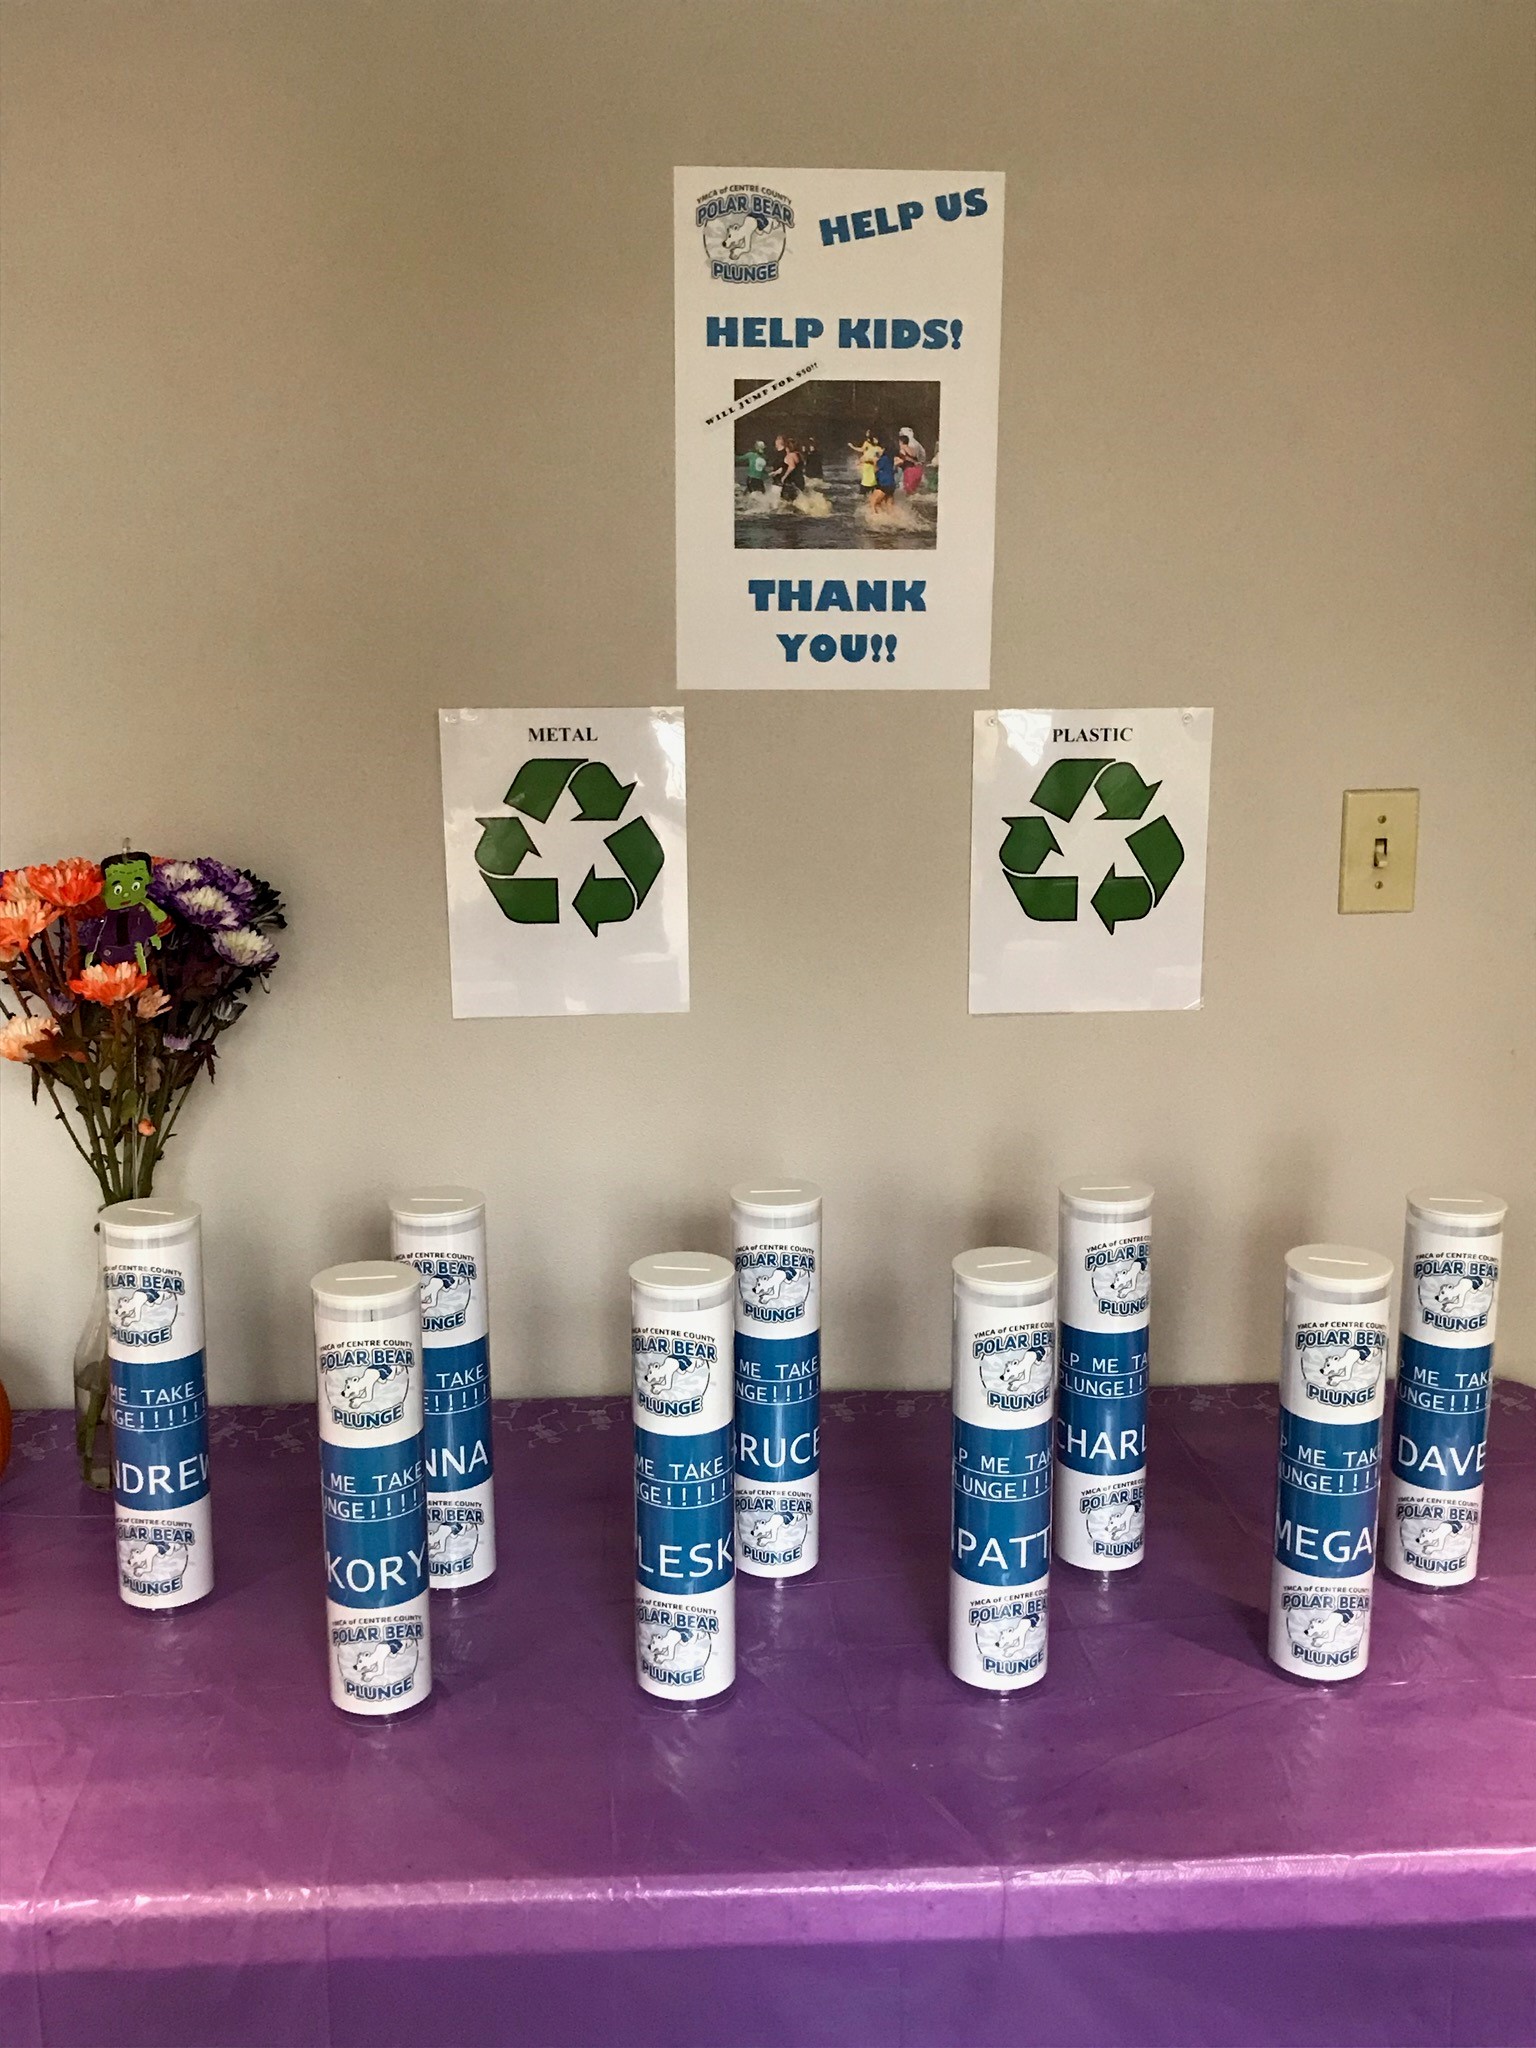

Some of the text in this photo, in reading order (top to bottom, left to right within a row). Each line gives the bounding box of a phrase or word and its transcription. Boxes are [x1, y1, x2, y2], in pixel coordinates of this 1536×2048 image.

[697, 184, 792, 205] YMCA of CENTRE COUNTY
[697, 195, 793, 227] POLAR BEAR
[819, 187, 988, 246] HELP US
[712, 261, 778, 282] PLUNGE
[706, 316, 963, 350] HELP KIDS!
[705, 407, 735, 425] WILL
[739, 389, 768, 409] JUMP
[772, 376, 794, 390] FOR
[748, 579, 927, 612] THANK
[776, 634, 898, 663] YOU!!
[528, 727, 598, 742] METAL
[1052, 727, 1134, 743] PLASTIC
[447, 1253, 475, 1261] COUNTY
[790, 1246, 814, 1254] COUNTY
[1086, 1245, 1135, 1270] POLAR
[1087, 1243, 1107, 1253] YMCA
[151, 1267, 182, 1277] COUNTY
[439, 1261, 476, 1278] BEAR
[736, 1253, 815, 1272] POLAR BEAR
[1415, 1261, 1463, 1278] POLAR
[142, 1276, 183, 1293] BEAR
[422, 1312, 465, 1330] UNGE
[744, 1303, 804, 1322] PLUNGE
[1424, 1310, 1487, 1331] PLUNGE
[650, 1328, 681, 1336] CENTRE
[684, 1331, 715, 1343] COUNTY
[974, 1329, 996, 1339] YMCA
[1009, 1323, 1039, 1332] CENTRE
[1296, 1331, 1350, 1348] POLAR
[347, 1340, 380, 1348] CENTRE
[383, 1340, 412, 1348] COUNTY
[634, 1336, 716, 1361] OLAR BEAR
[974, 1333, 1029, 1358] POLAR
[320, 1349, 414, 1372] POLAR BEAR
[740, 1355, 818, 1379] ME TAKE
[1092, 1358, 1119, 1373] ME
[436, 1363, 484, 1388] TAKE
[1414, 1366, 1440, 1387] ME
[140, 1381, 195, 1405] TAKE
[988, 1386, 1050, 1410] PLUNGE
[1308, 1384, 1376, 1405] PLUNGE
[638, 1393, 701, 1416] PLUNGE
[333, 1404, 403, 1428] PLUNGE
[981, 1456, 1010, 1474] ME
[1298, 1445, 1326, 1466] ME
[1399, 1434, 1487, 1476] DAVE
[330, 1460, 422, 1493] ME TAKE
[668, 1456, 723, 1480] TAKE
[1081, 1487, 1101, 1496] YMCA
[1081, 1491, 1128, 1512] POLAR
[446, 1509, 484, 1524] BEAR
[736, 1498, 813, 1514] POLAR BEAR
[1396, 1505, 1443, 1519] POLAR
[152, 1527, 194, 1544] BEAR
[638, 1531, 733, 1578] LESK
[743, 1545, 801, 1564] PLUNGE
[1405, 1551, 1466, 1572] PLUNGE
[326, 1541, 426, 1593] KORY
[430, 1556, 473, 1575] UNGE
[653, 1601, 683, 1610] CENTRE
[685, 1605, 717, 1615] COUNTY
[970, 1598, 991, 1607] YMCA
[1283, 1595, 1334, 1609] POLAR
[639, 1607, 718, 1632] OLAR BEAR
[970, 1603, 1023, 1624] POLAR
[332, 1624, 424, 1644] POLAR BEAR
[984, 1649, 1044, 1675] PLUNGE
[1293, 1644, 1358, 1665] PLUNGE
[642, 1660, 703, 1685] PLUNGE
[346, 1676, 413, 1700] PLUNGE
